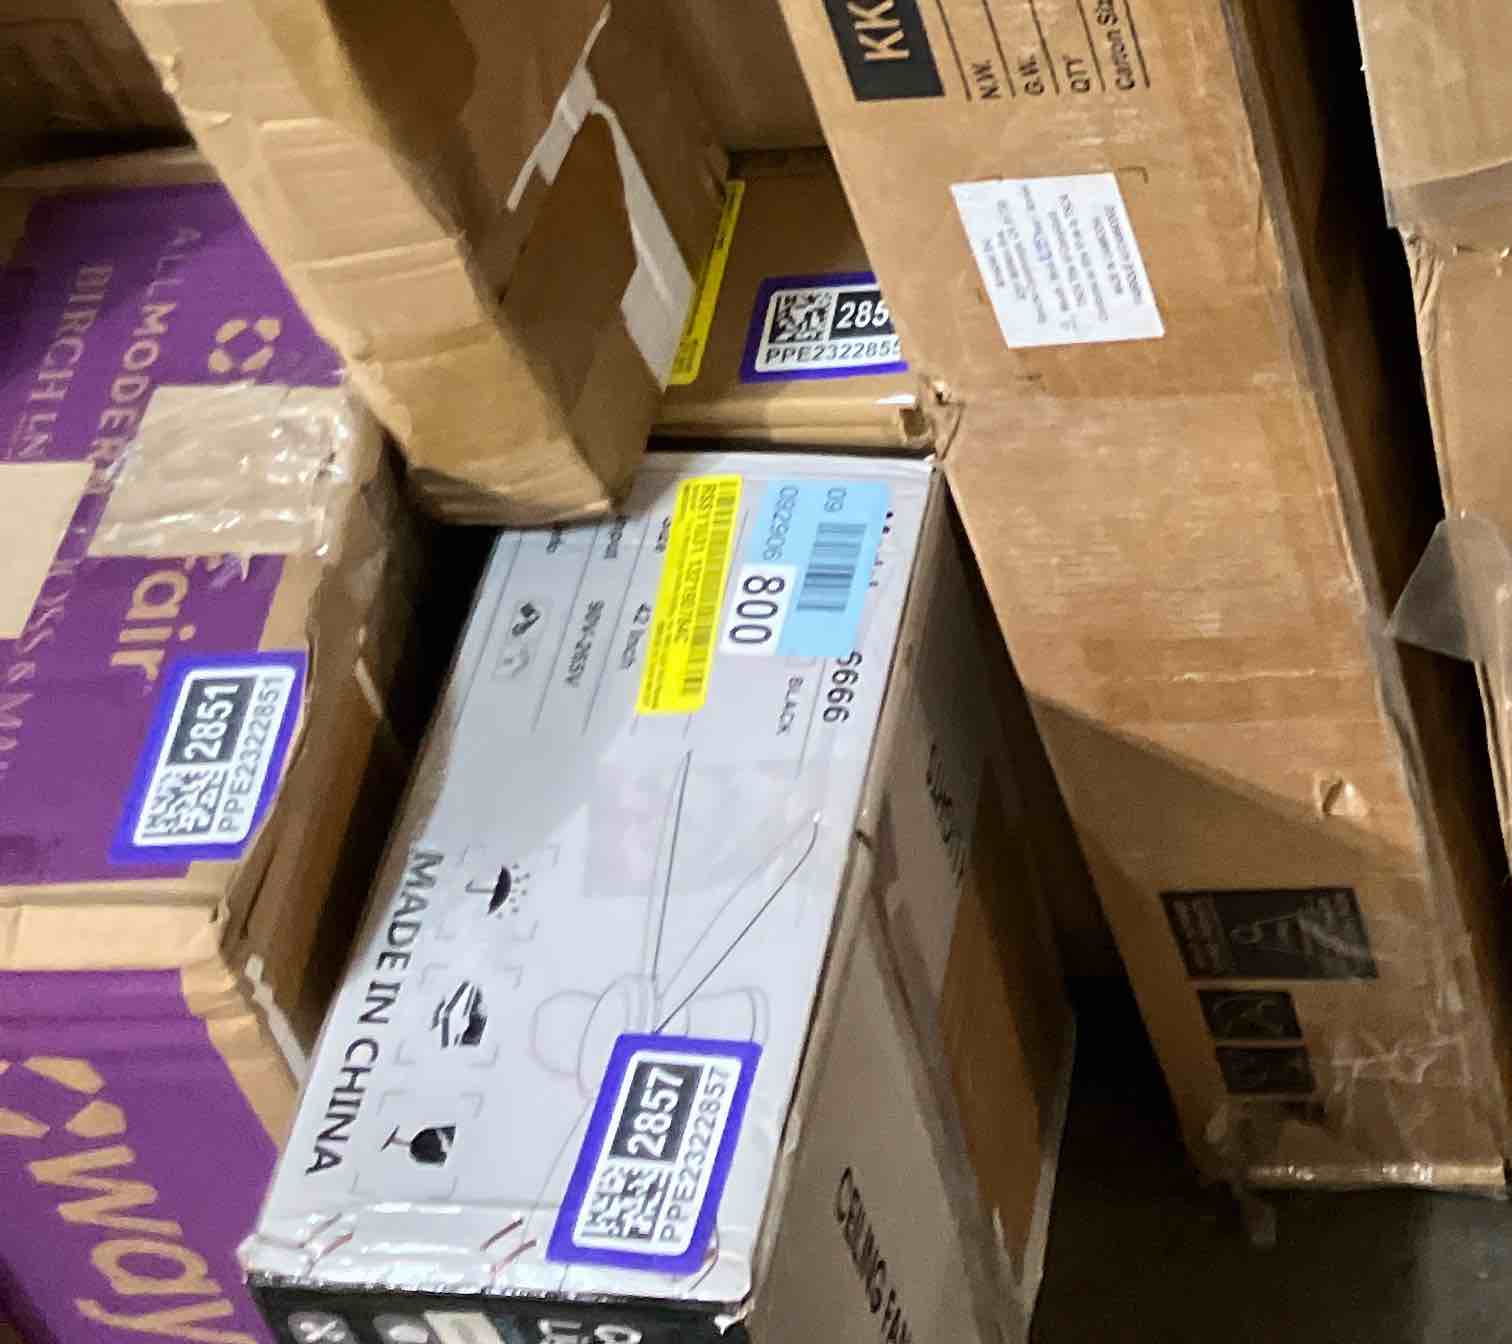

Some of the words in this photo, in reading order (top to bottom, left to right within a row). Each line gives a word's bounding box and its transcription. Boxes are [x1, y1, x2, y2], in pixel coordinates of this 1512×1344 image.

[836, 300, 890, 329] 285
[762, 485, 799, 561] 092906
[823, 487, 847, 512] 09
[728, 574, 786, 645] 800
[184, 682, 242, 762] 2851
[776, 676, 804, 735] BLACK
[217, 676, 285, 833] PPE2322851
[376, 849, 445, 972] MADE
[352, 978, 403, 1027] IN
[305, 1036, 380, 1176] CHINA
[626, 1066, 686, 1158] 2857
[658, 1064, 731, 1243] PPE2322857
